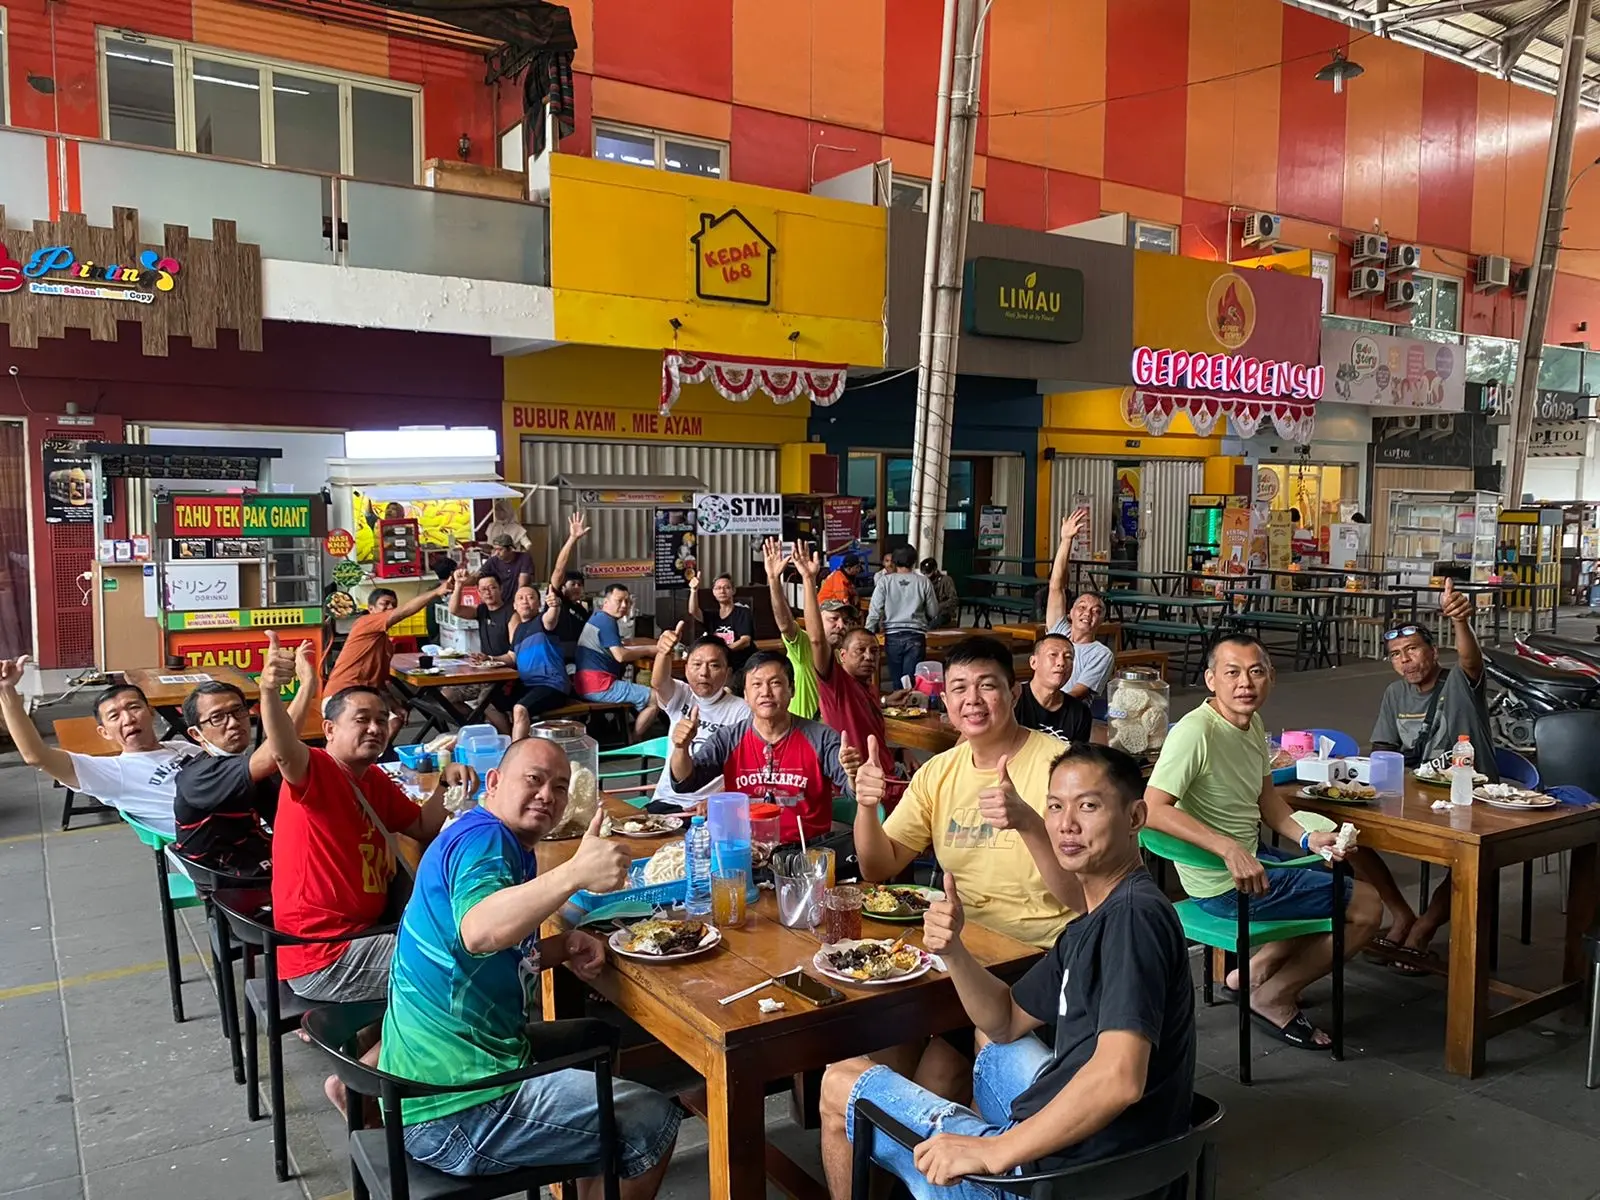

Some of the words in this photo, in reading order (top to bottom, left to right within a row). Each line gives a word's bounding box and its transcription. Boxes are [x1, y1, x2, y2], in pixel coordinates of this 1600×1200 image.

[704, 241, 761, 268] KEDAI
[722, 263, 752, 284] 168
[31, 284, 58, 294] Print
[63, 286, 96, 296] Sablon
[129, 292, 153, 302] Copy
[1000, 286, 1060, 312] LIMAU
[513, 406, 569, 430] BUBUR
[574, 410, 616, 432] AYAM
[632, 413, 658, 434] MIE
[664, 416, 702, 436] AYAM
[176, 506, 211, 528] TAHU
[214, 506, 241, 528] TEK
[243, 505, 267, 528] PAK
[270, 506, 308, 528] GIANT
[731, 497, 780, 516] STMJ
[589, 566, 614, 574] BAKSO
[616, 565, 652, 573] BAROKAH
[172, 579, 227, 595] ドリンク
[187, 649, 252, 669] TAHU
